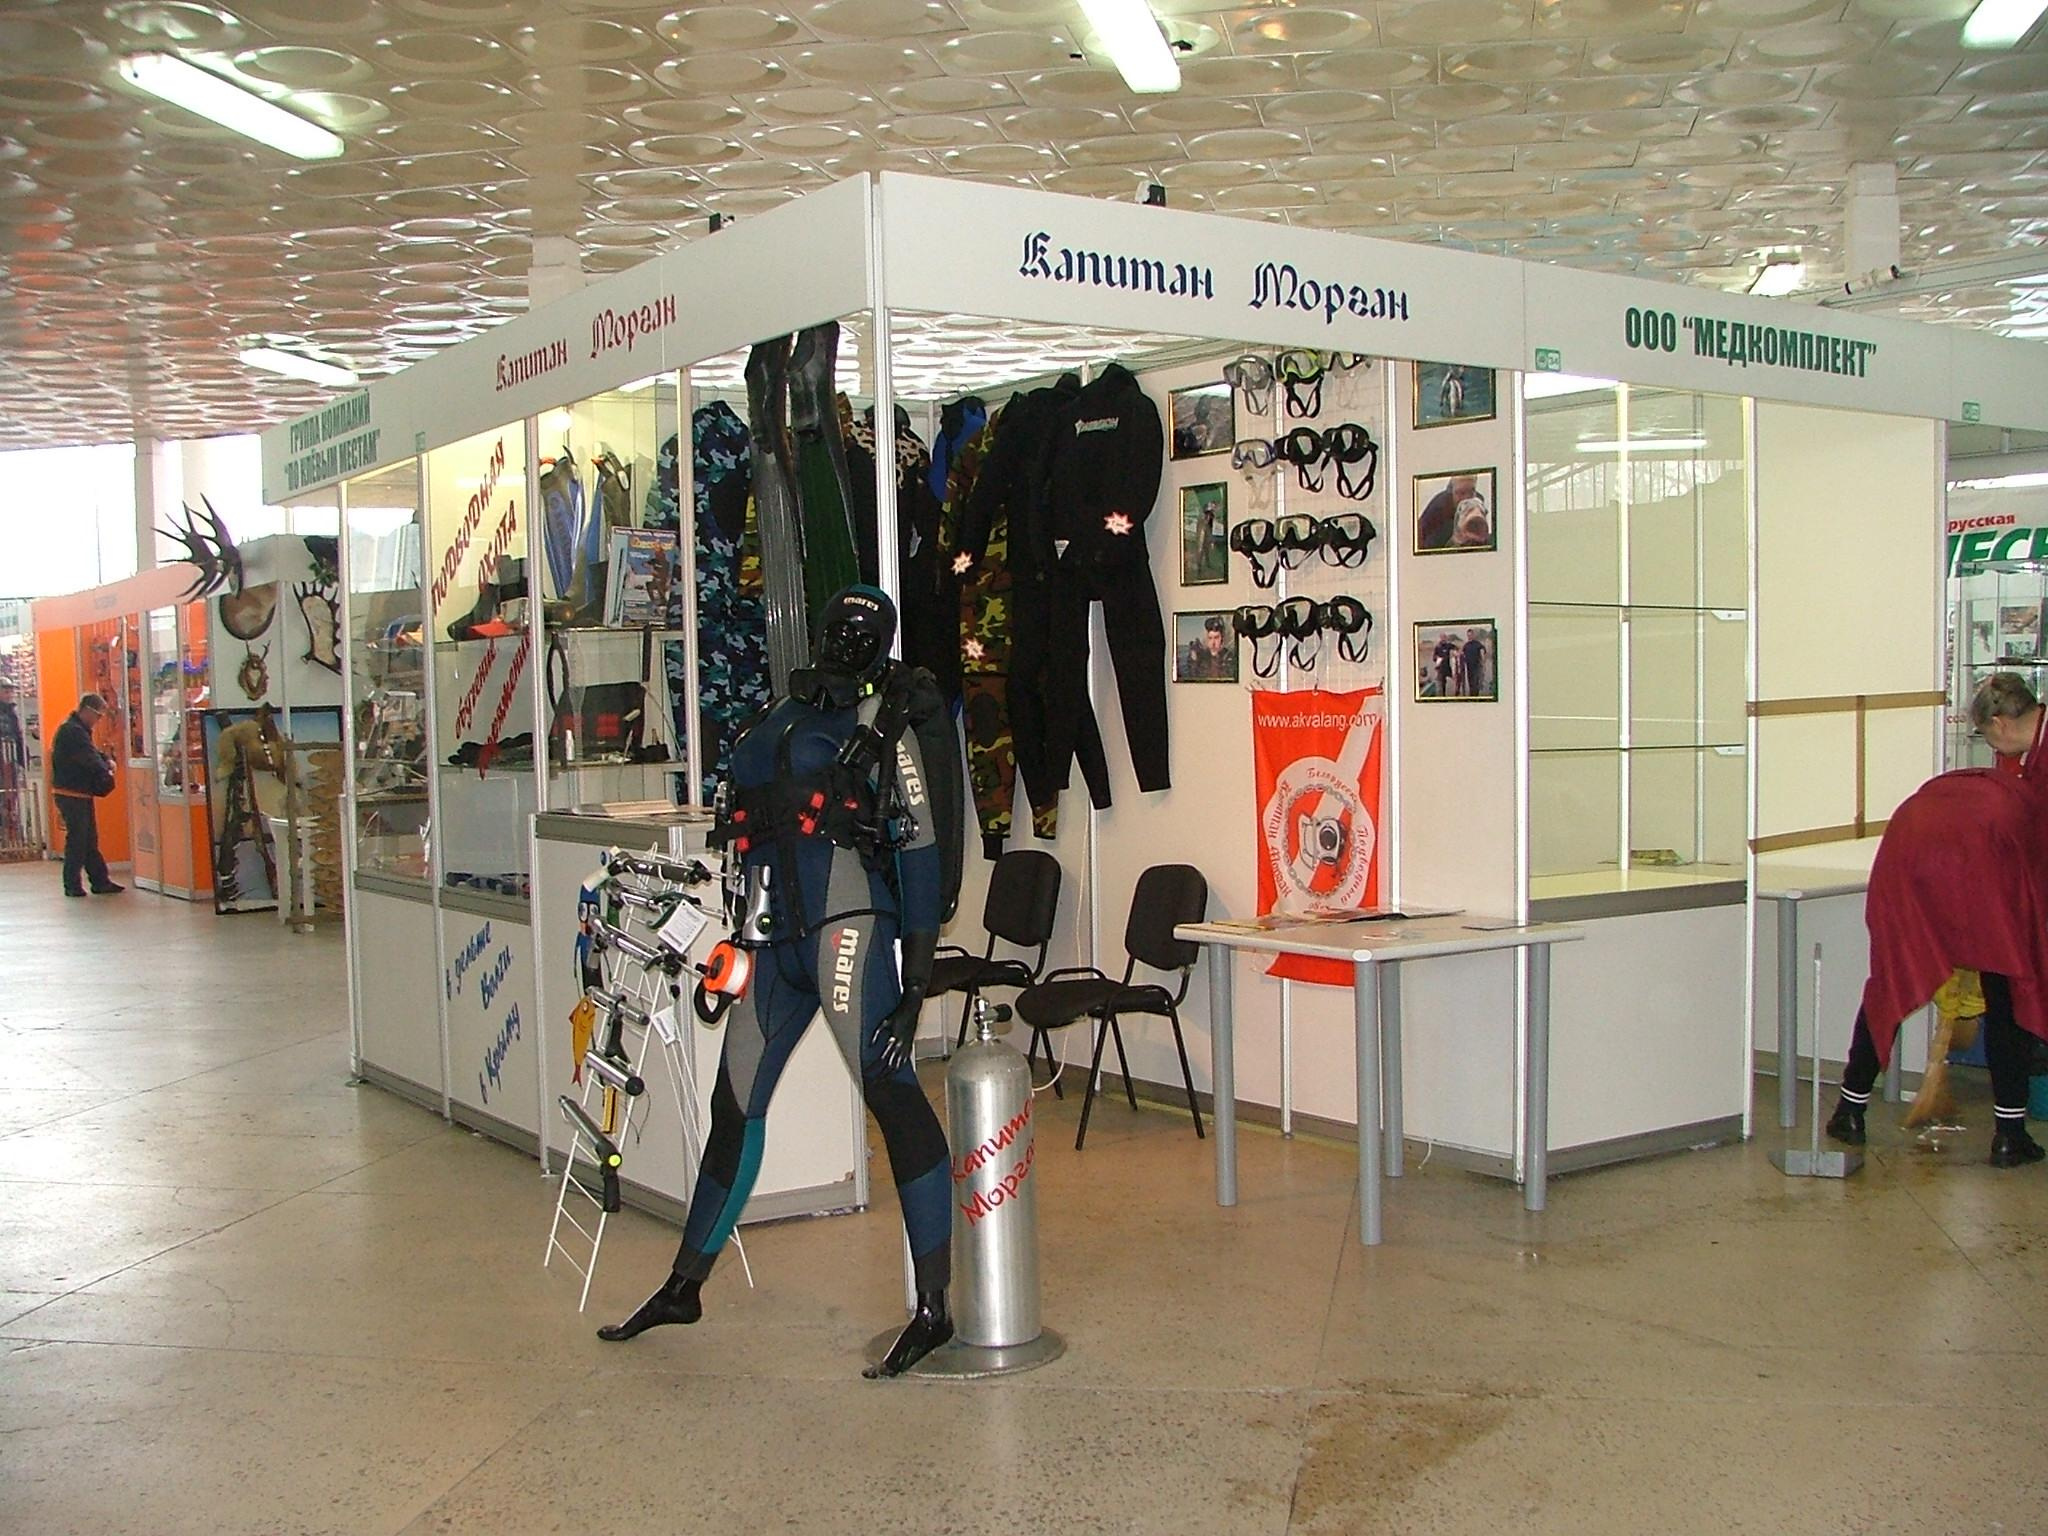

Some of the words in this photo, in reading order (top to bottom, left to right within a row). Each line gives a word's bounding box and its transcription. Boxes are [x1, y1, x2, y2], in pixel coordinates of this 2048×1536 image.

[1019, 231, 1214, 300] Капитан
[1247, 262, 1409, 325] Морган
[495, 338, 568, 392] Капитан
[590, 294, 677, 359] Морган
[1625, 307, 1676, 353] ООО
[290, 415, 321, 454] ГРУППА
[1947, 514, 2016, 533] русская
[843, 596, 880, 611] mares
[1257, 711, 1378, 732] www.akvalang.com
[833, 928, 859, 1014] mares
